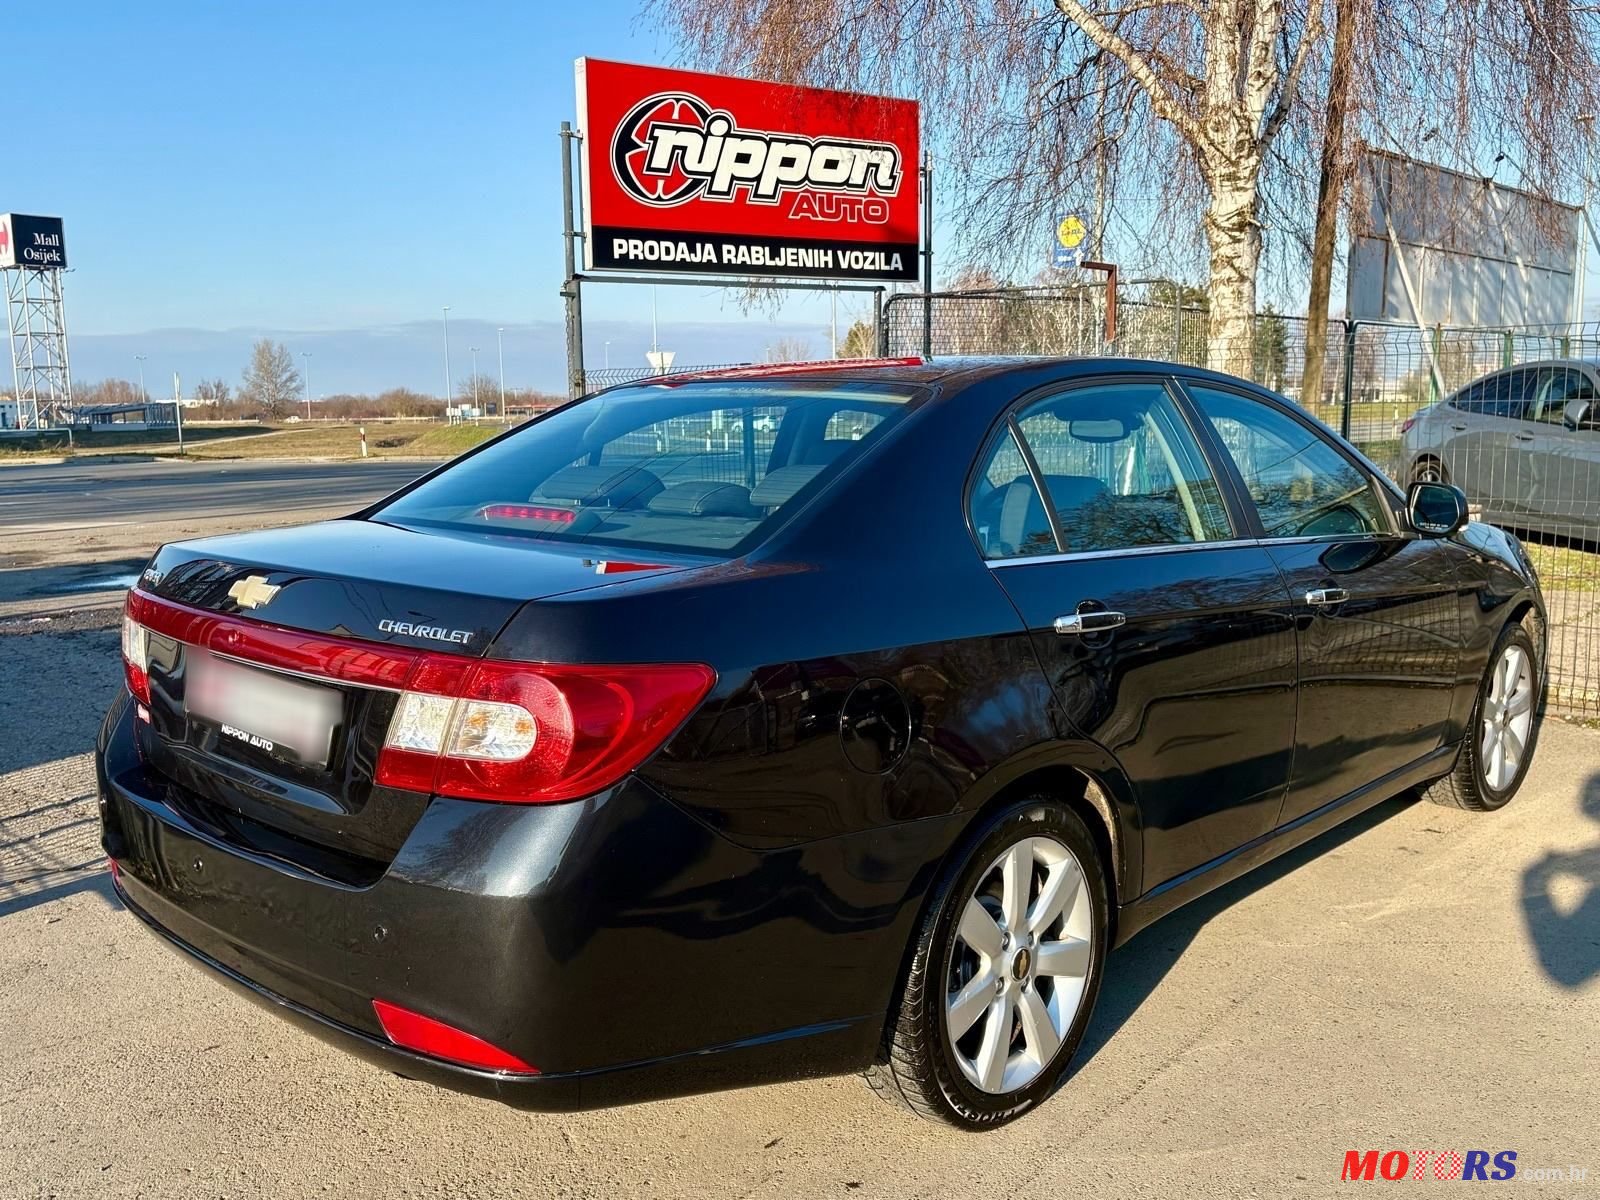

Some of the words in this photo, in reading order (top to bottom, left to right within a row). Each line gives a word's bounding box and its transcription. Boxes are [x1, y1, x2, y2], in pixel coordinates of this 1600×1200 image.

[644, 112, 899, 201] nippon
[788, 192, 890, 224] AUTO
[33, 232, 60, 246] Mall
[23, 247, 61, 264] Osijek
[612, 238, 718, 265] PRODAJA
[722, 244, 833, 269] RABLJENIH
[838, 250, 904, 272] VOZILA
[378, 619, 474, 644] CHEVROLET
[221, 723, 250, 743] NIPPON
[249, 736, 273, 752] AUTO
